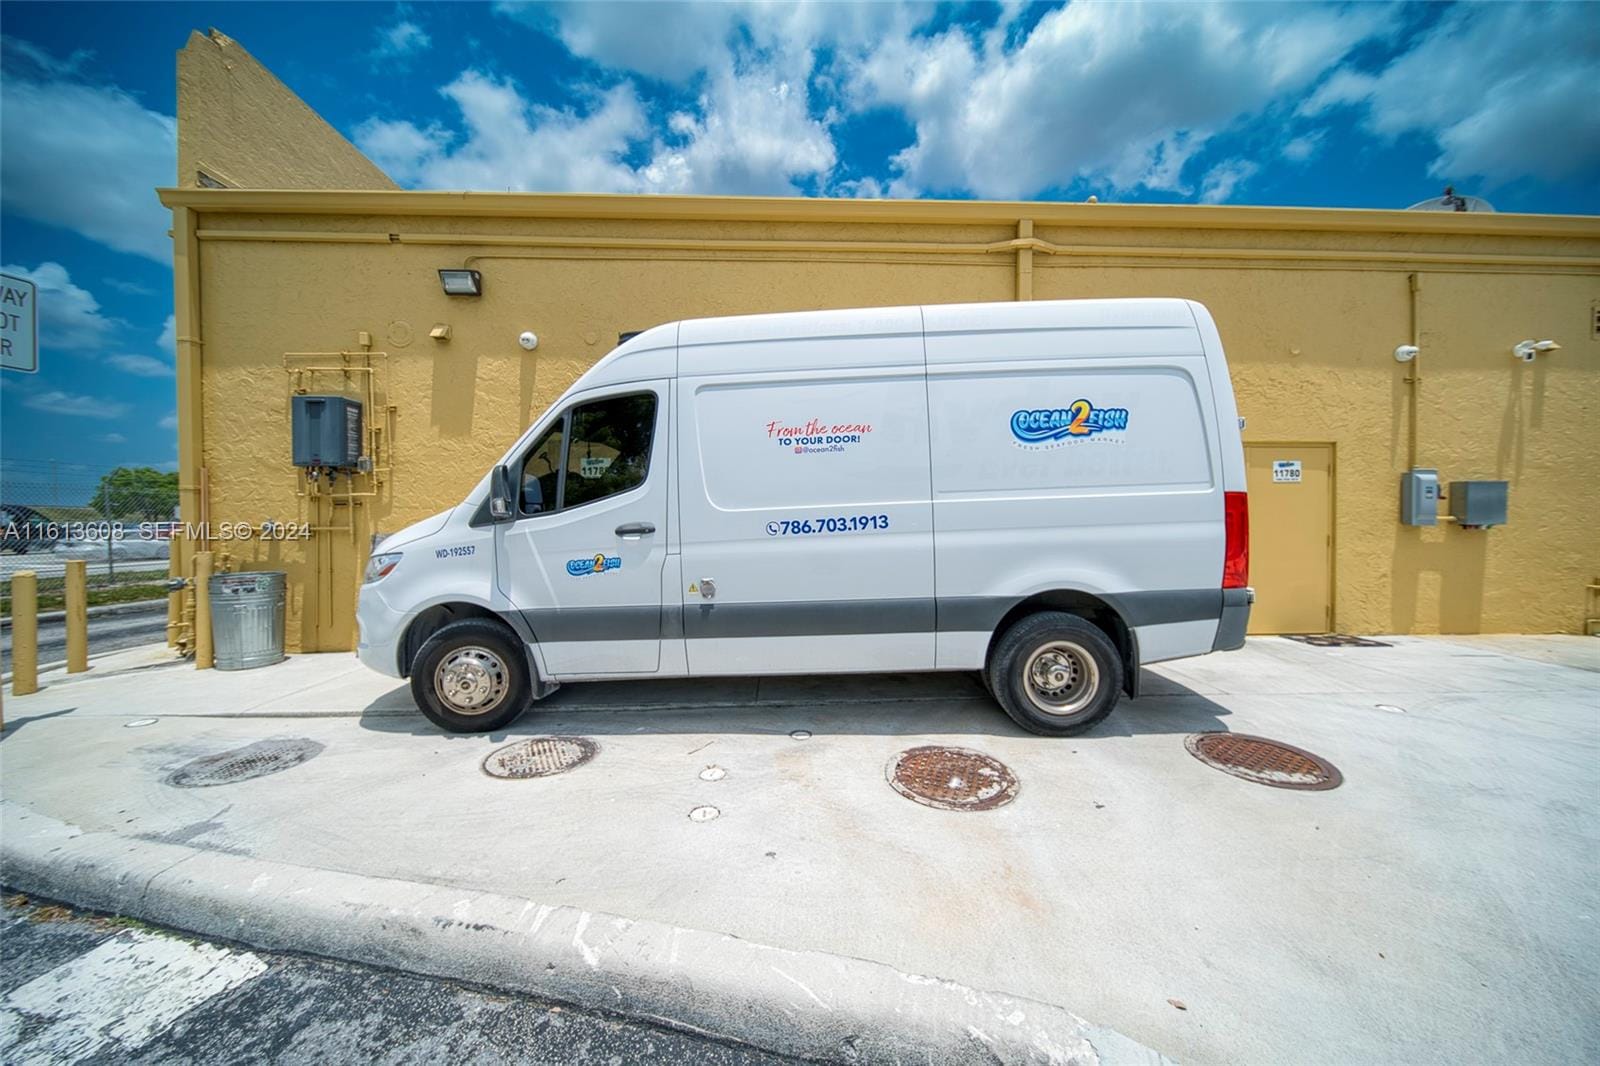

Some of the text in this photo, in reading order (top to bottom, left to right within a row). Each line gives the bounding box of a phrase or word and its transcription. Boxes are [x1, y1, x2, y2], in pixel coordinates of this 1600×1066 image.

[0, 286, 28, 307] AY
[766, 418, 873, 438] From the ocean
[778, 434, 861, 446] TO YOUR DOOR!
[1274, 469, 1301, 478] 11780
[780, 514, 889, 535] 786.703.1913
[435, 545, 476, 559] WD-192557
